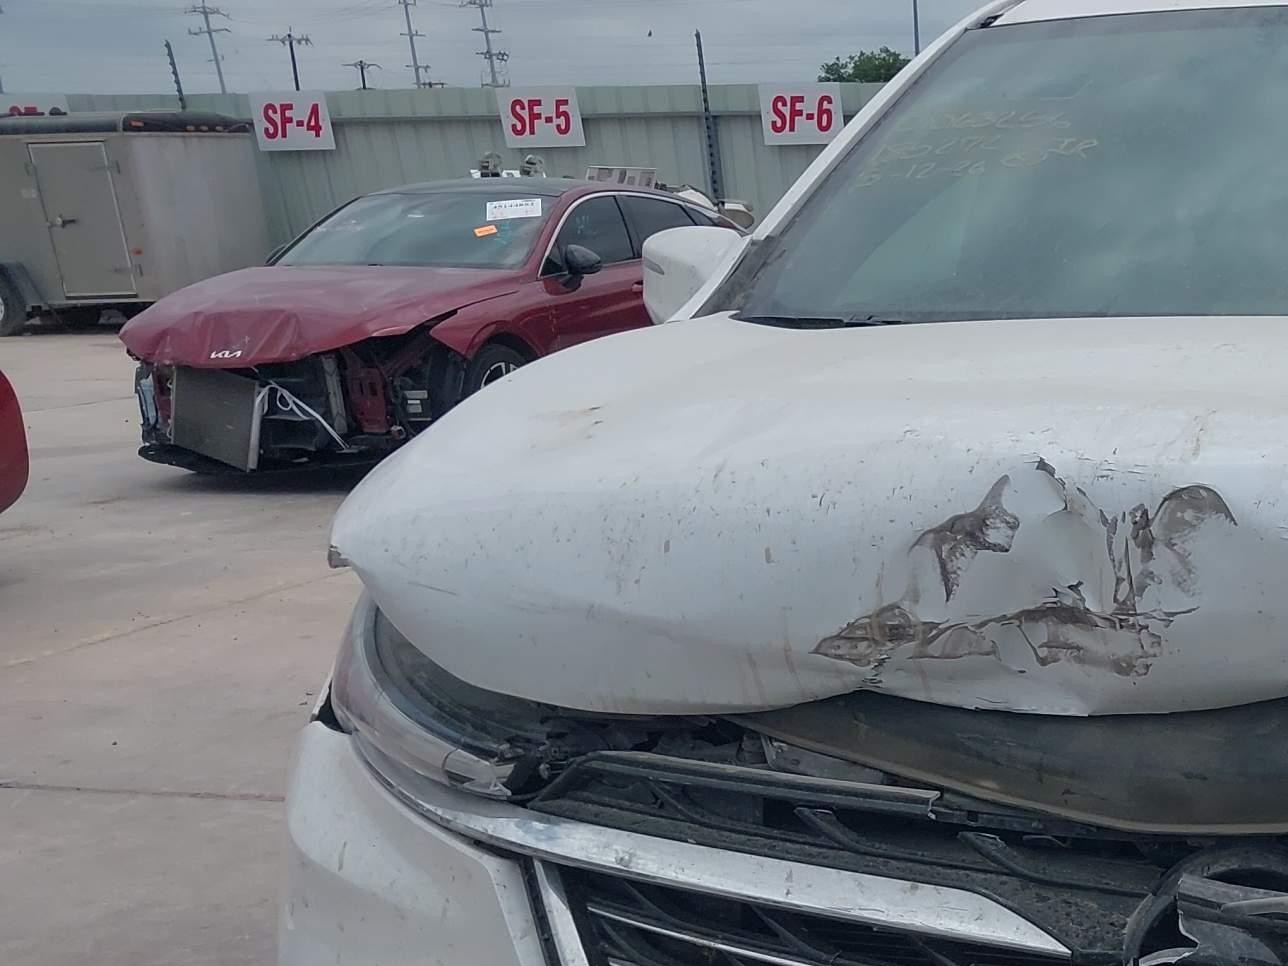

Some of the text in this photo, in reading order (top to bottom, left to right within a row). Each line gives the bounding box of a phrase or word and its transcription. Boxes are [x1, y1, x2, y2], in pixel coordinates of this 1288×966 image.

[263, 102, 322, 139] SF-4
[510, 98, 571, 136] SF-5
[770, 95, 833, 133] SF-6
